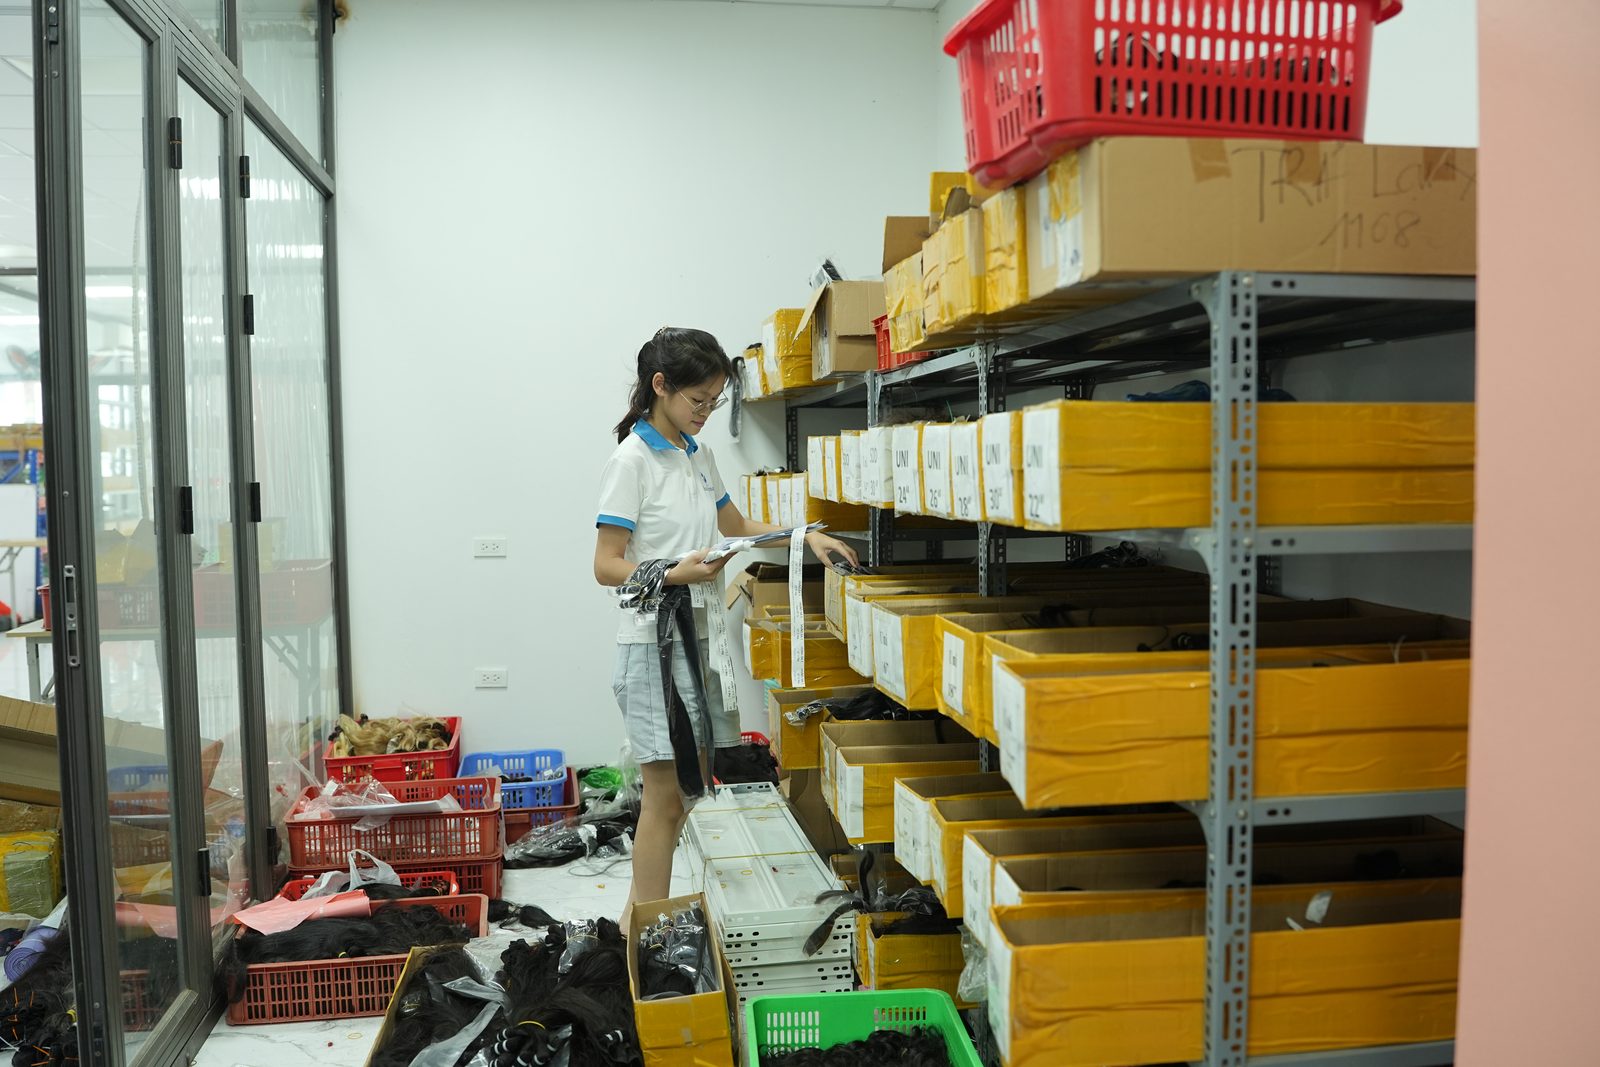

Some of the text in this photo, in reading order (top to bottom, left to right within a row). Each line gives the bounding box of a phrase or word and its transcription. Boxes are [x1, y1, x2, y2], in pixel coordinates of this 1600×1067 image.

[896, 450, 909, 468] UNI
[927, 450, 941, 470] UNI
[985, 443, 1001, 466] UNI
[1026, 444, 1044, 469] UNI
[955, 455, 969, 476] UNI
